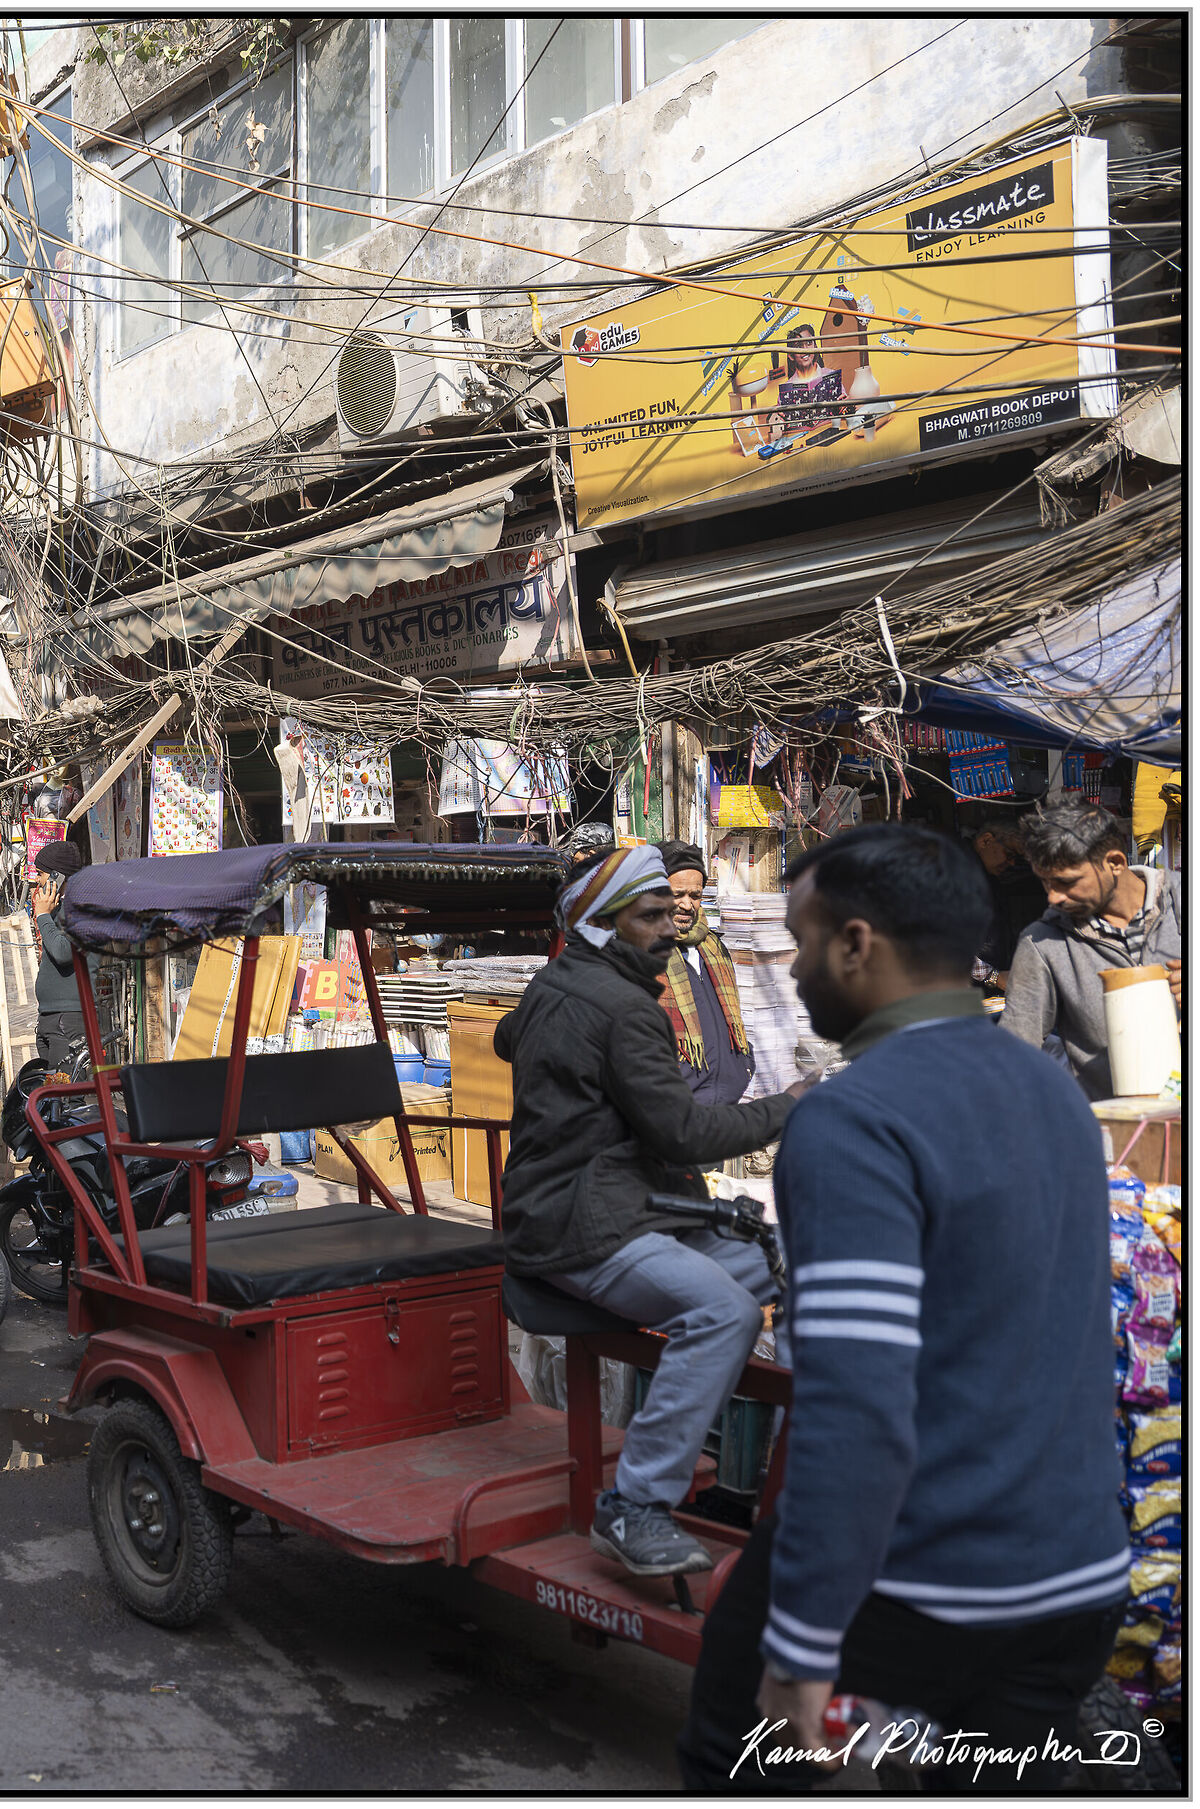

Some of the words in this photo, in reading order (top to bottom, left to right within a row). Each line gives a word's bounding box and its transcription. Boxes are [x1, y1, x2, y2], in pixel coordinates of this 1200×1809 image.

[916, 238, 962, 262] ENJOY
[969, 211, 1046, 246] LEARNING
[600, 323, 623, 341] edu
[601, 329, 638, 351] GAMES
[580, 408, 646, 438] UNLIMITED
[649, 399, 680, 418] FUN,
[925, 408, 988, 432] BHAGWATI
[991, 398, 1029, 417] BOOK
[1032, 386, 1078, 408] DEPOT
[582, 430, 629, 455] JOYFUL
[631, 411, 699, 439] LEARNING
[957, 428, 971, 440] M.
[974, 411, 1043, 437] 9711269809
[587, 503, 611, 515] Creative
[281, 620, 353, 670] कमल
[358, 573, 547, 658] पुस्तकालय
[414, 640, 441, 659] BOOKS
[443, 642, 451, 654] &
[453, 626, 520, 651] DICTIONARIES
[314, 970, 340, 1000] B
[317, 1142, 333, 1155] PLAN
[413, 1146, 437, 1156] Printed
